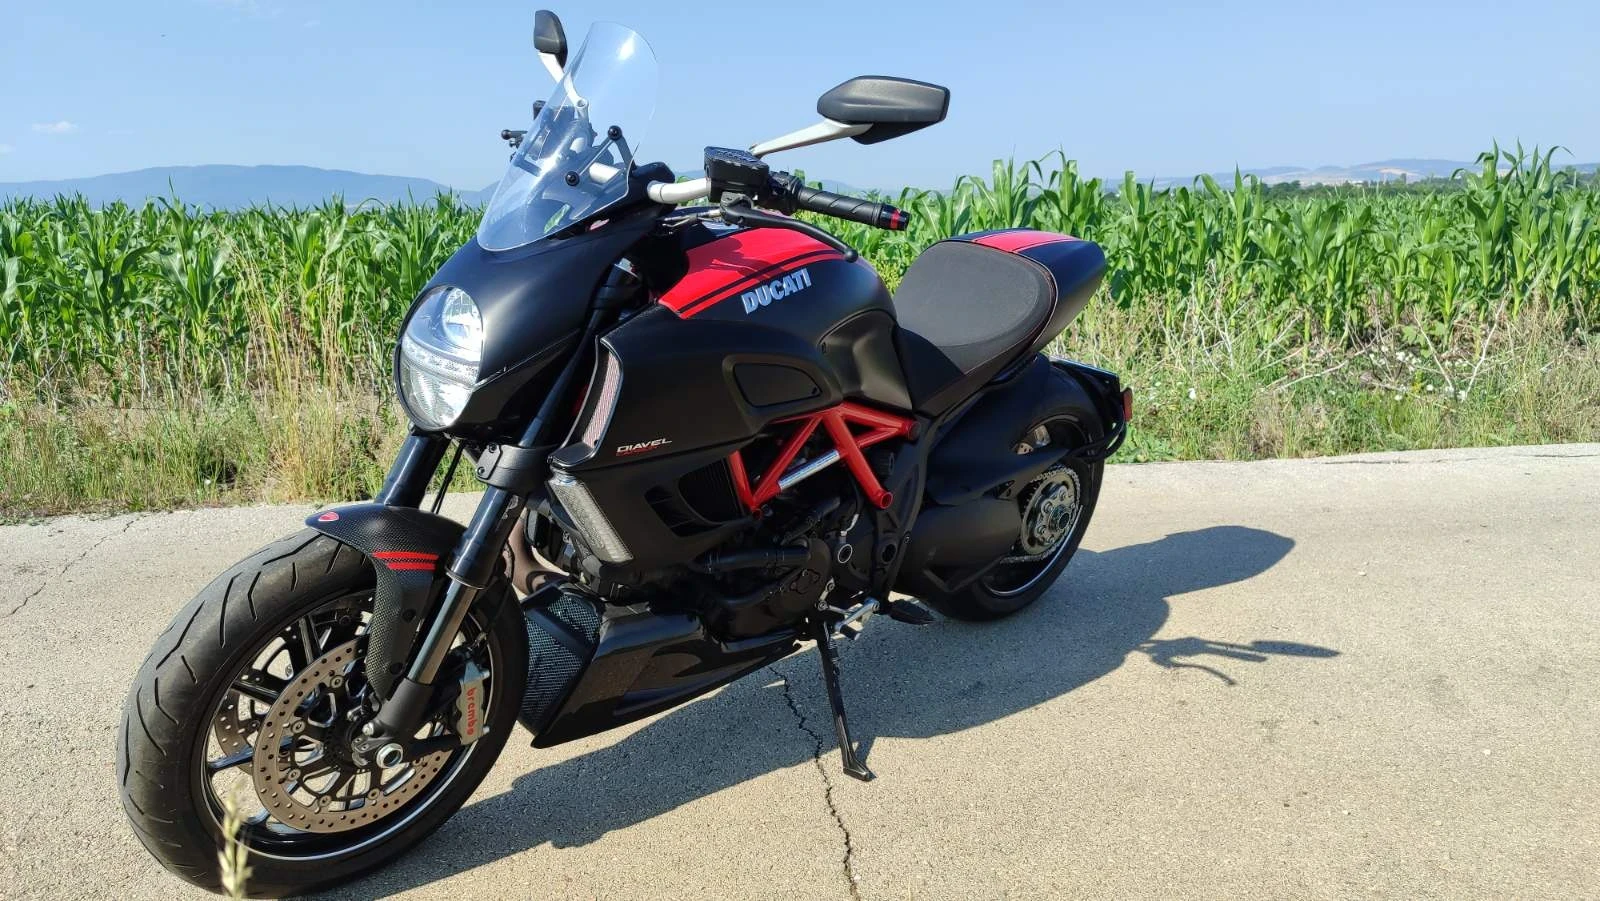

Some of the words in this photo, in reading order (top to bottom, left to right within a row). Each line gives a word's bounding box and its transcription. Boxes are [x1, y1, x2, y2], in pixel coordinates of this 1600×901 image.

[741, 268, 812, 314] DUCATI
[616, 438, 672, 453] DIAVEL
[466, 687, 478, 736] brembo
